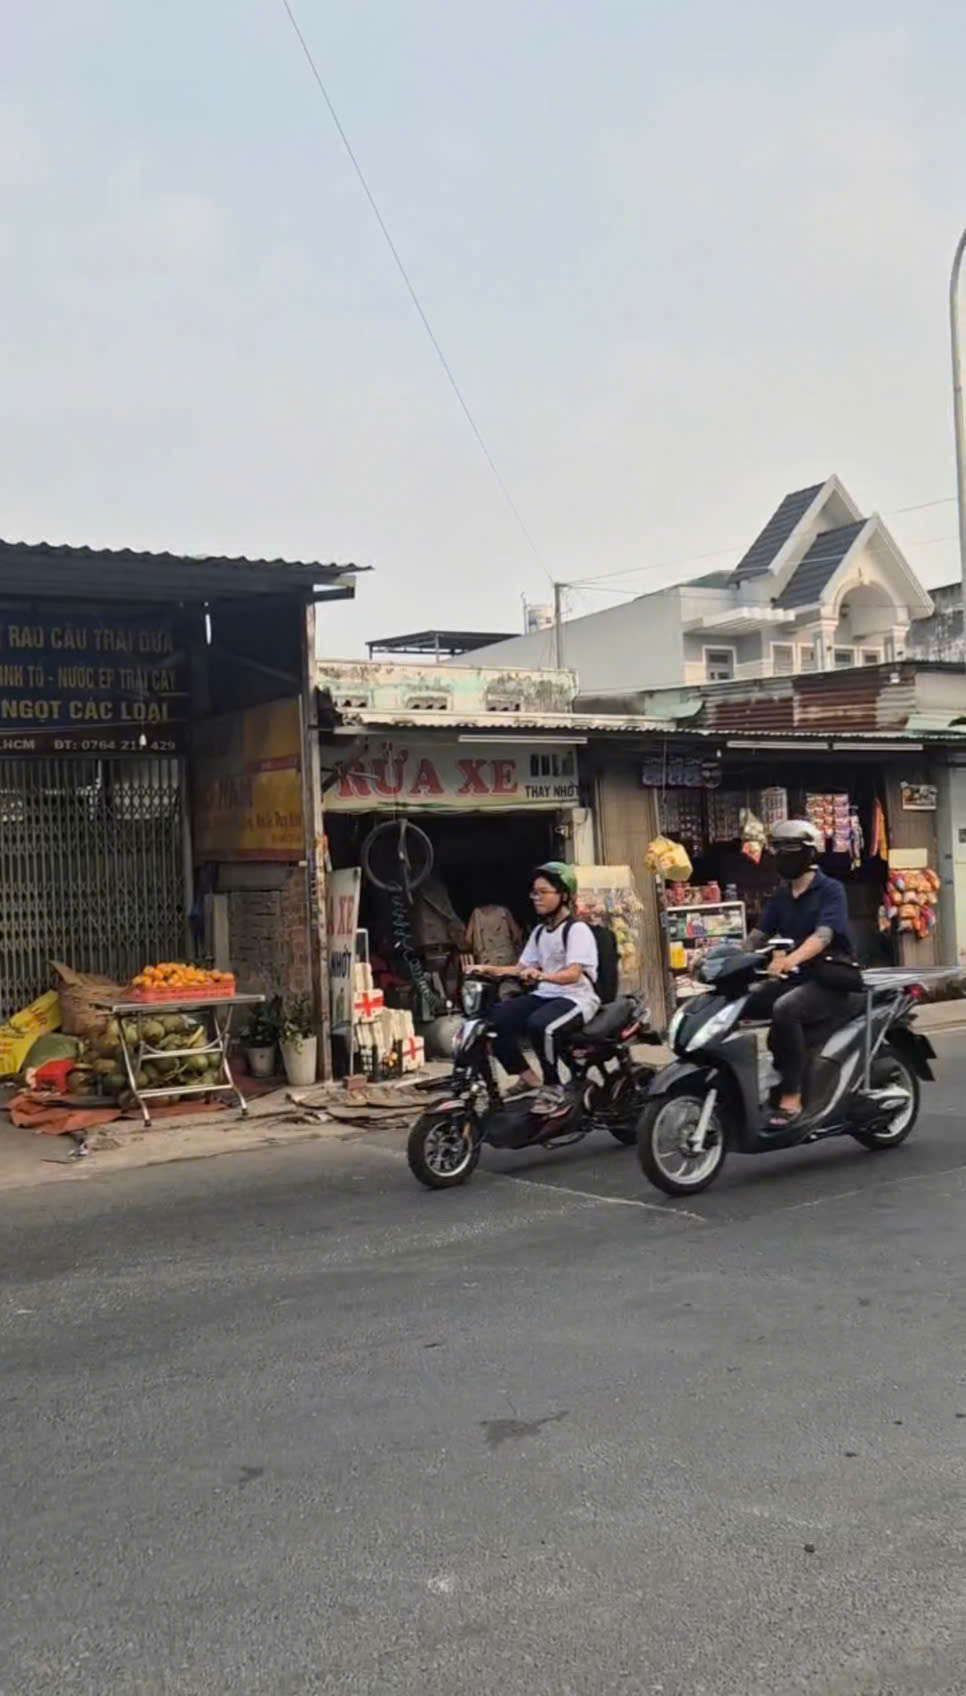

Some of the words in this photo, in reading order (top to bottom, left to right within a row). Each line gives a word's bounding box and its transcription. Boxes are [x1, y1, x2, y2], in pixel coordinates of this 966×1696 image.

[1, 698, 62, 723] NGỌT
[69, 696, 113, 720] CÁC
[455, 754, 519, 796] XE
[525, 785, 551, 798] THAY
